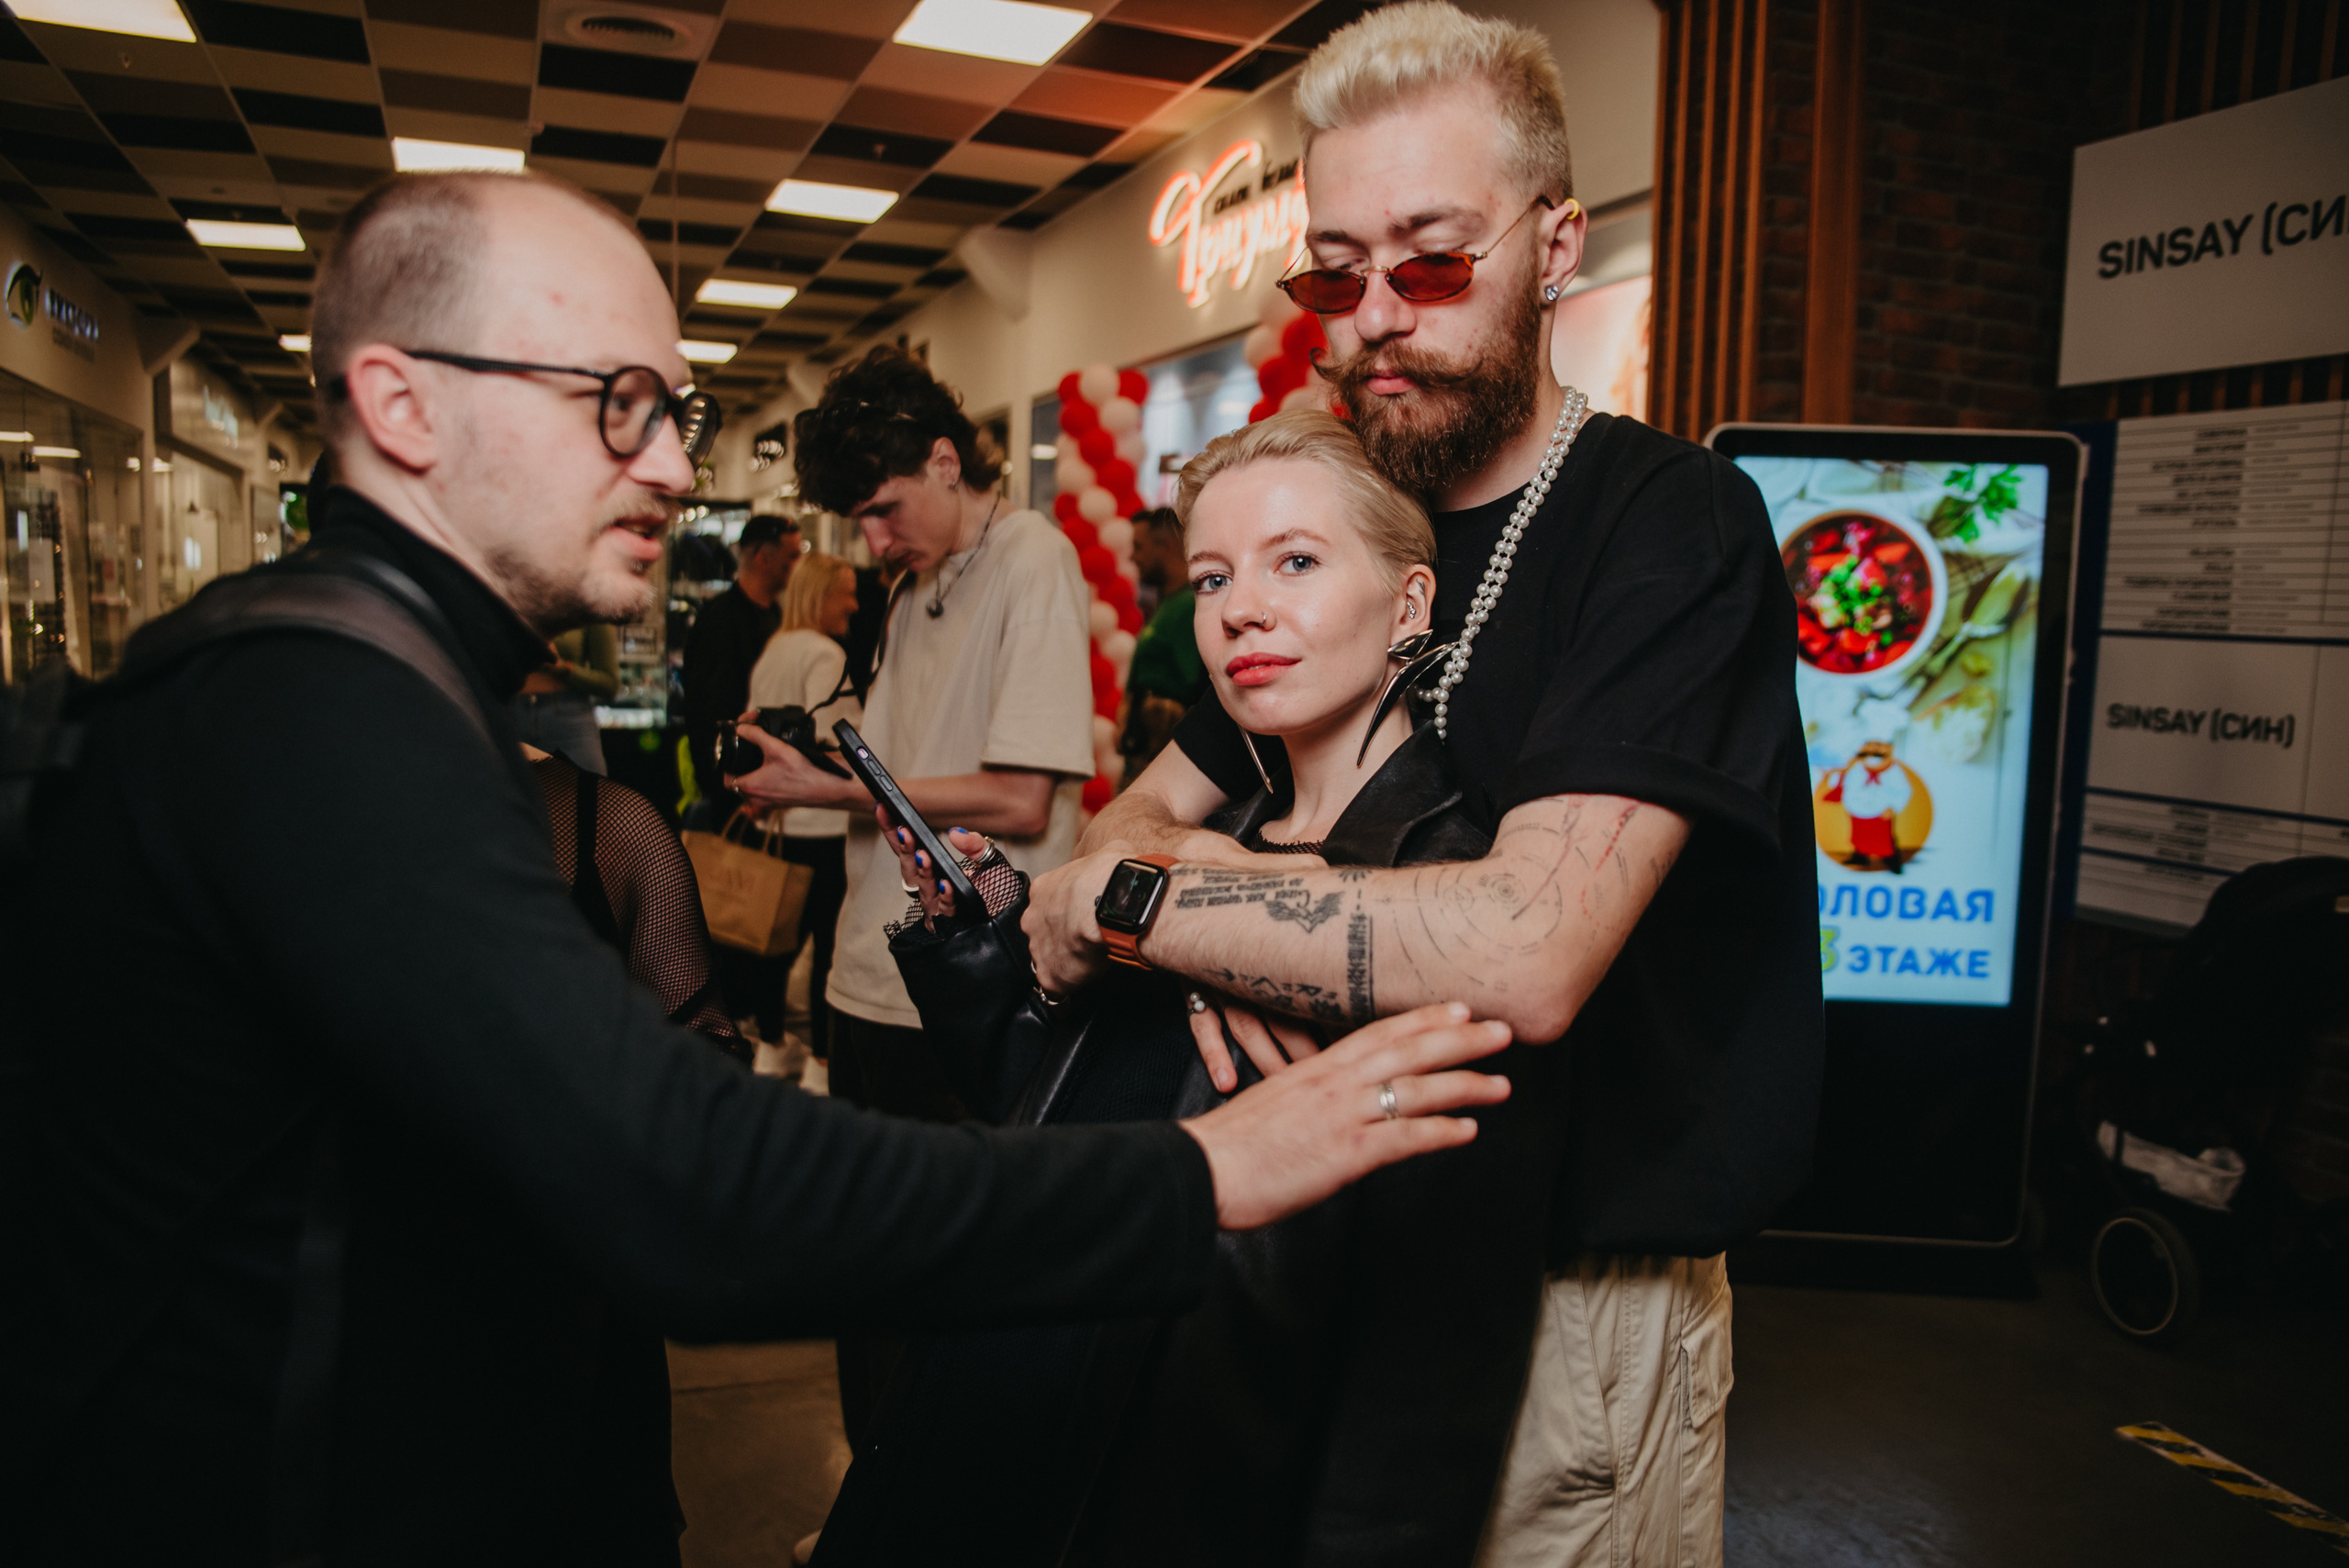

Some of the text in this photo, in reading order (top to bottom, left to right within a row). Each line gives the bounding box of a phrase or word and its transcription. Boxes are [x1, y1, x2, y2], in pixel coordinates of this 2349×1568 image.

[2098, 195, 2349, 280] SINSAY (СИ
[2106, 703, 2297, 749] SINSAY (СИН)
[1818, 884, 1995, 922] ЛОВАЯ
[1848, 944, 1991, 978] ЭТАЖЕ
